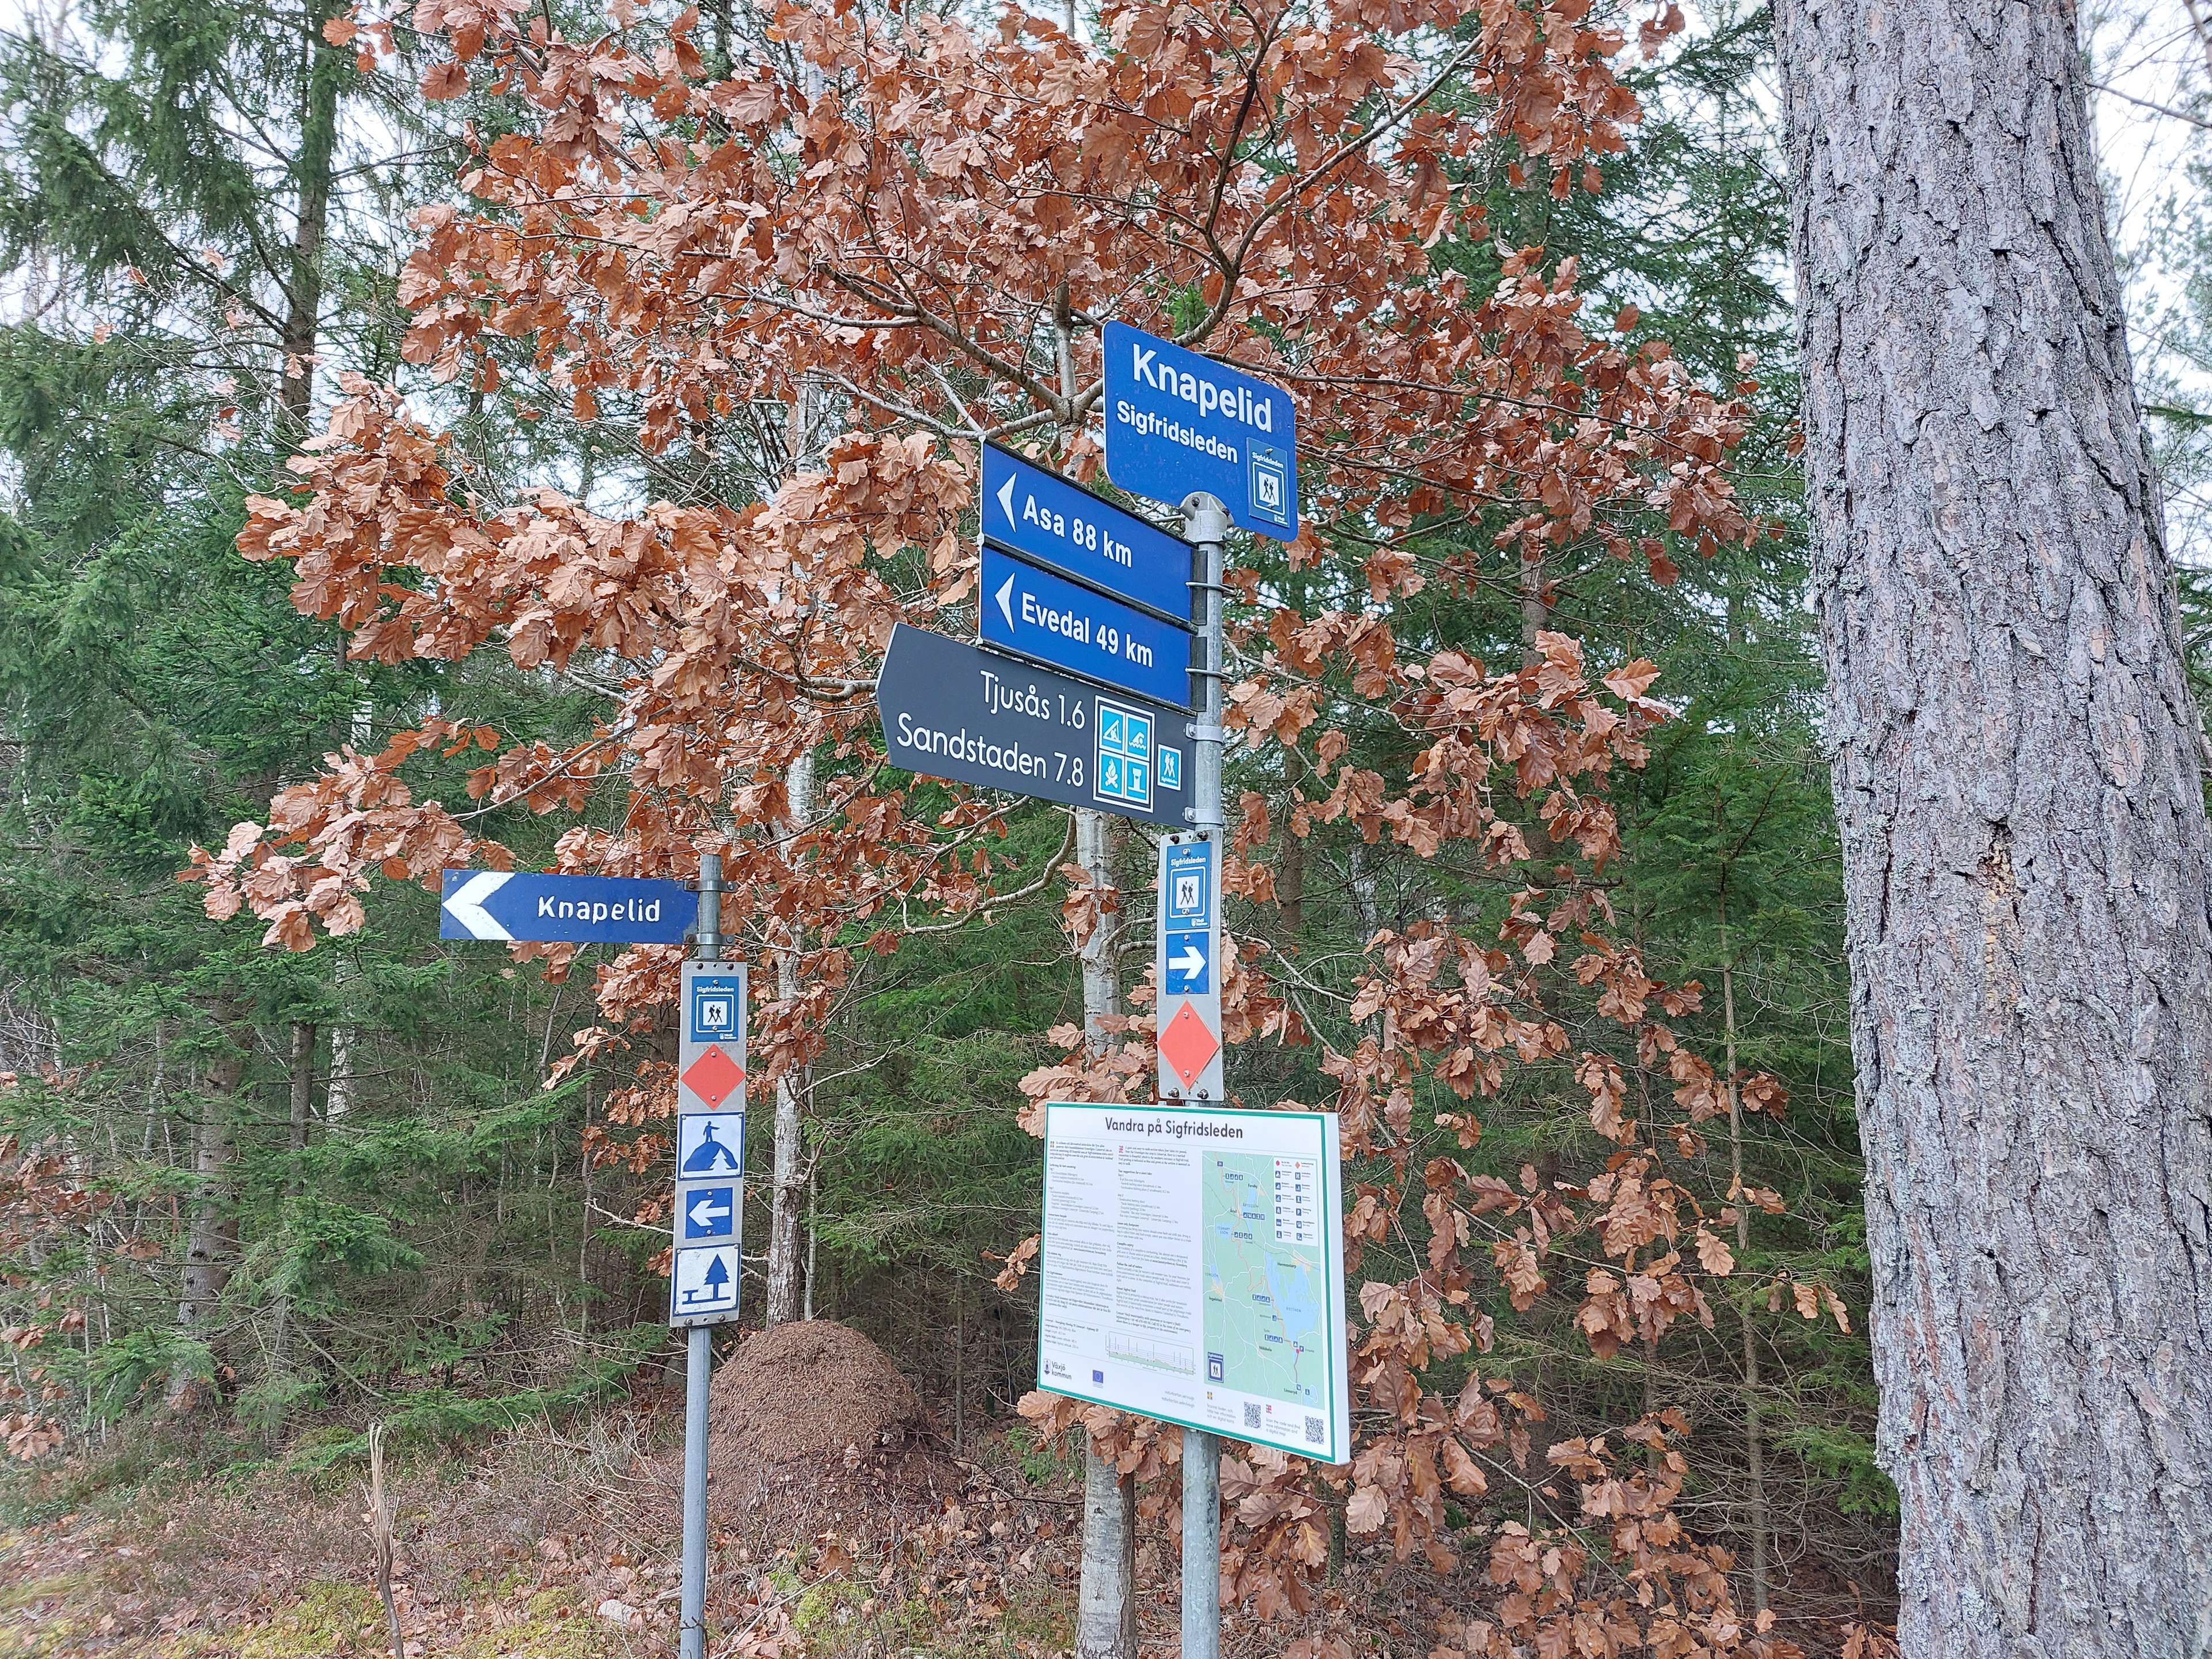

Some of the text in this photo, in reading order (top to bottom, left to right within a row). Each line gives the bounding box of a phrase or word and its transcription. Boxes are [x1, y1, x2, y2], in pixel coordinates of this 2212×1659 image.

[1133, 343, 1272, 433] Knapelid
[1116, 400, 1238, 464] Sigfridsleden
[1022, 493, 1132, 568] Asa 88 km
[1021, 592, 1153, 668] Evedal 49 km
[980, 670, 1086, 729] Tjusås 1.6
[896, 711, 1084, 787] Sandstaden 7.8
[1170, 856, 1207, 868] Sigfridsleden
[537, 895, 661, 926] Knapelid
[696, 986, 735, 994] Sigfridsleden
[1105, 1117, 1244, 1139] Vandra på Sigfridsleden
[1051, 1360, 1066, 1372] Växjö
[1051, 1369, 1072, 1380] kommun
